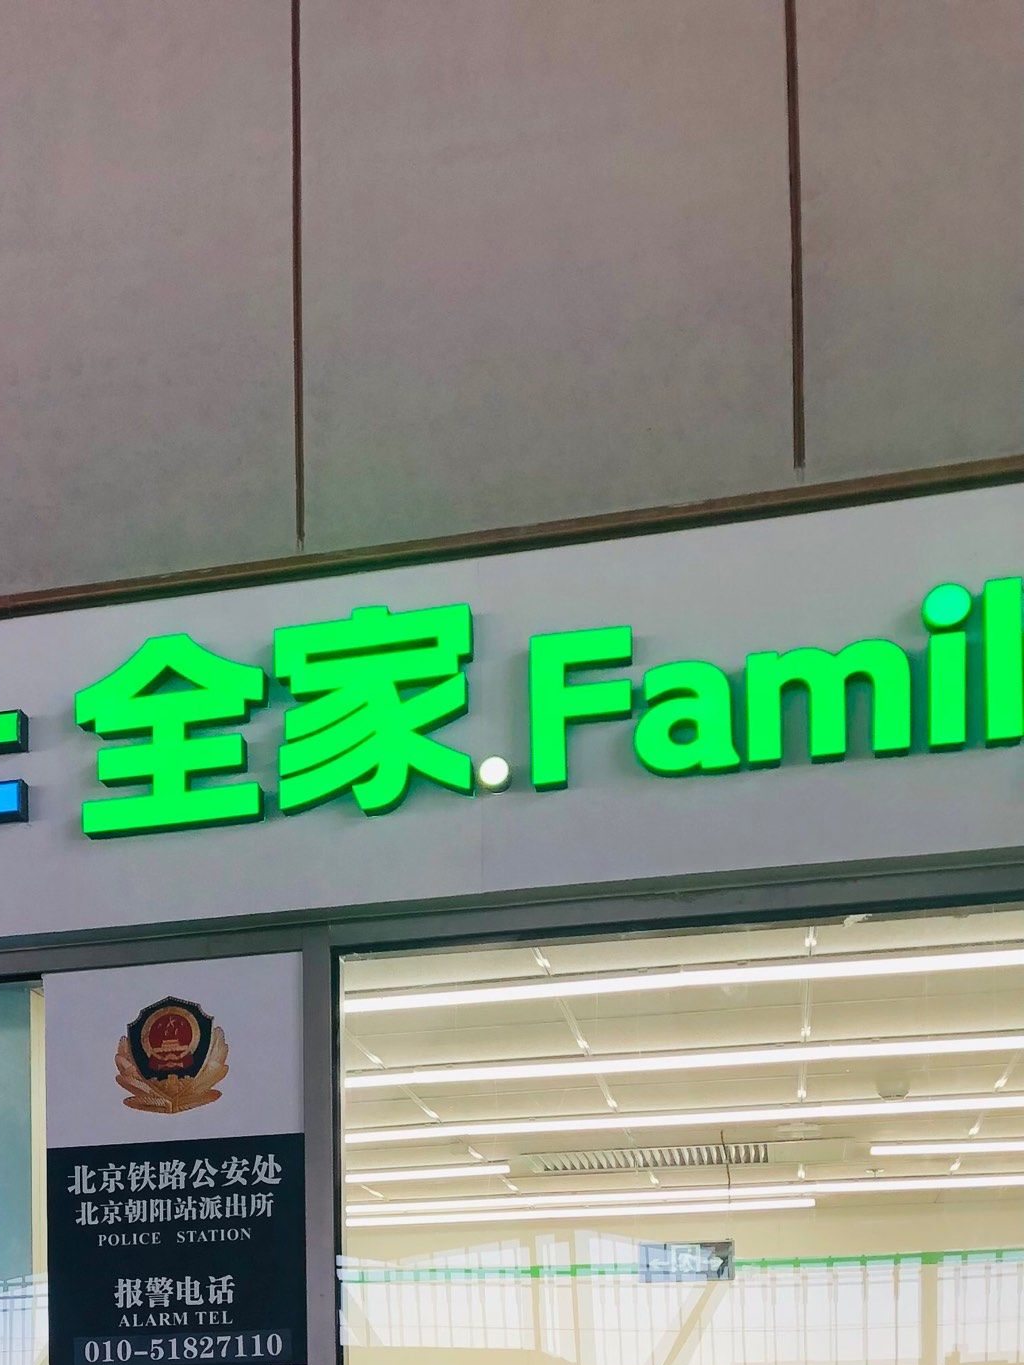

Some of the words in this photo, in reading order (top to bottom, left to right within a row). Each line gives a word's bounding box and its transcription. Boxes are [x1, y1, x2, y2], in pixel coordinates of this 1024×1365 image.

[74, 603, 474, 840] 全家
[529, 576, 1024, 792] Famil
[67, 1153, 283, 1196] 北京铁路公安处
[75, 1192, 275, 1226] 北京朝阳站派出所
[97, 1231, 162, 1247] POLICE
[176, 1227, 252, 1244] STATION
[114, 1274, 236, 1310] 报警电话
[118, 1311, 189, 1328] ALARM
[195, 1310, 233, 1326] TEL
[83, 1332, 283, 1364] 010-51827110
